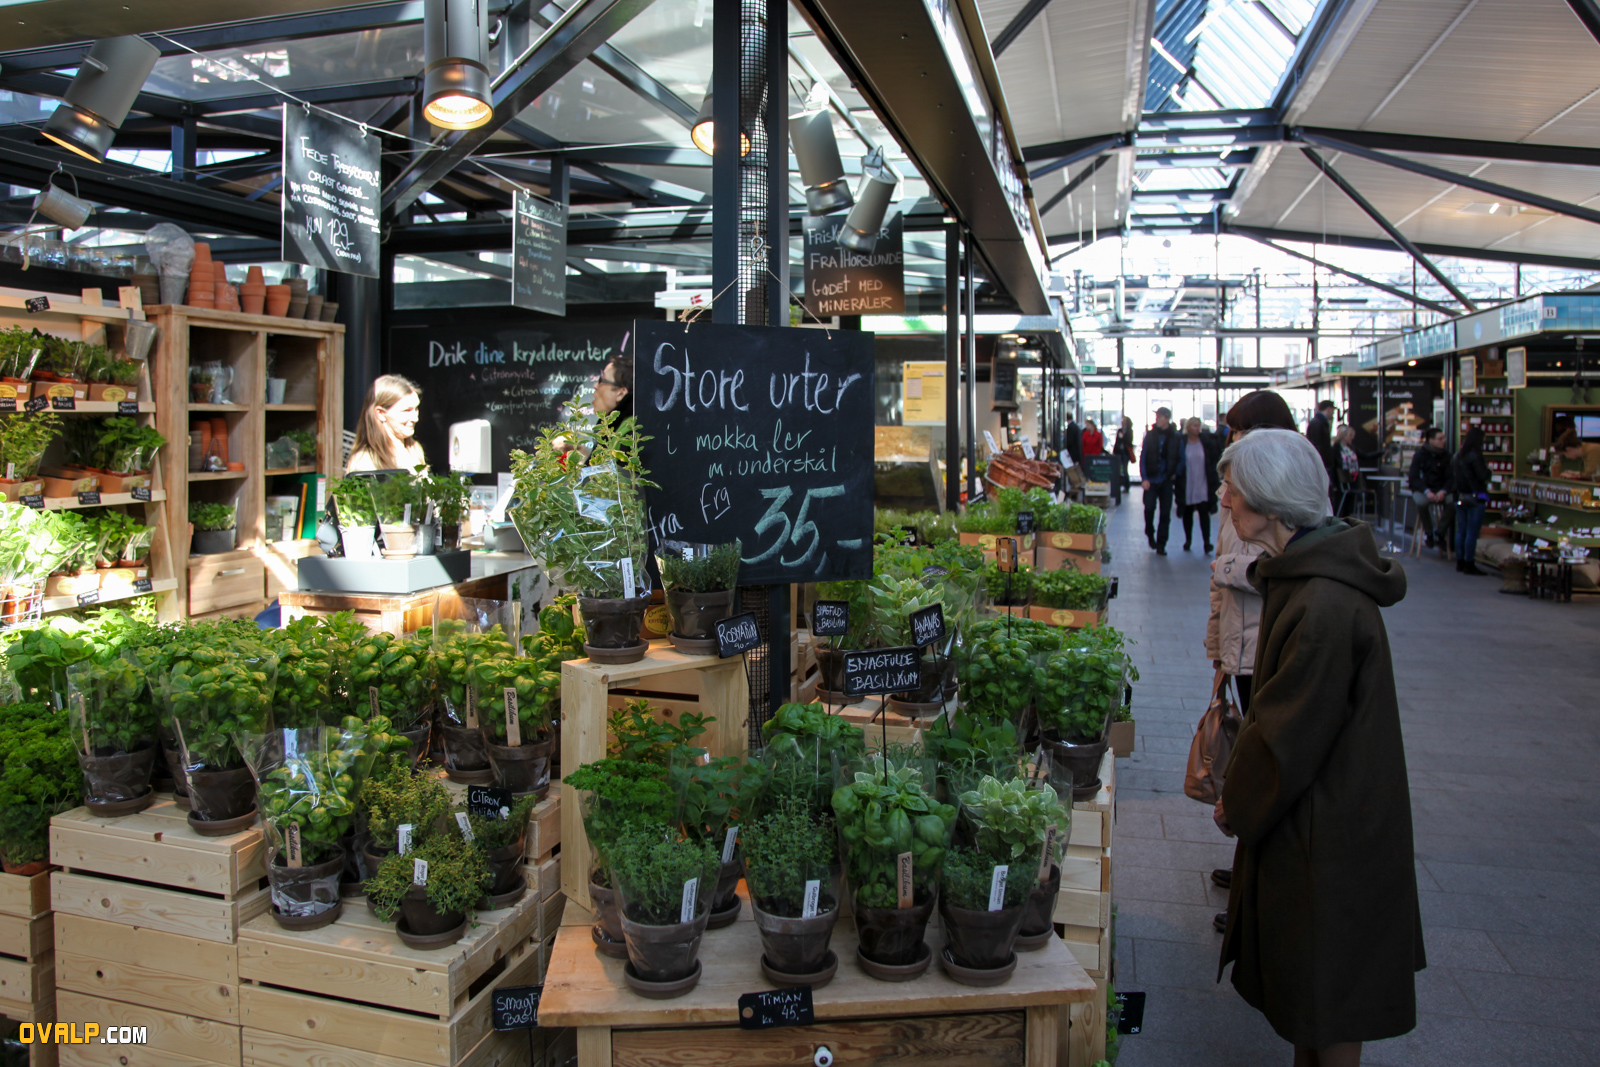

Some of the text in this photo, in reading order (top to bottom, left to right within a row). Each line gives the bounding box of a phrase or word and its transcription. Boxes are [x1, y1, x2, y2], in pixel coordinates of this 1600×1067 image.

[811, 253, 838, 270] FRA
[859, 280, 883, 293] MED
[429, 340, 467, 368] Drik
[474, 341, 506, 365] dine
[513, 340, 612, 366] krydderurter
[653, 342, 750, 413] Store
[770, 350, 862, 414] urter
[667, 418, 812, 455] i mokka ler
[738, 445, 837, 476] underskål
[914, 612, 940, 632] ANANAS
[847, 653, 915, 673] SMAGFULDE
[851, 670, 918, 691] BASiLiKUM
[506, 691, 517, 726] Basilikum
[471, 789, 501, 807] CiTRON
[287, 824, 299, 861] Basilikum
[1043, 828, 1057, 869] Basilikum
[901, 855, 911, 898] Basilikum
[758, 992, 802, 1006] TiMiAN
